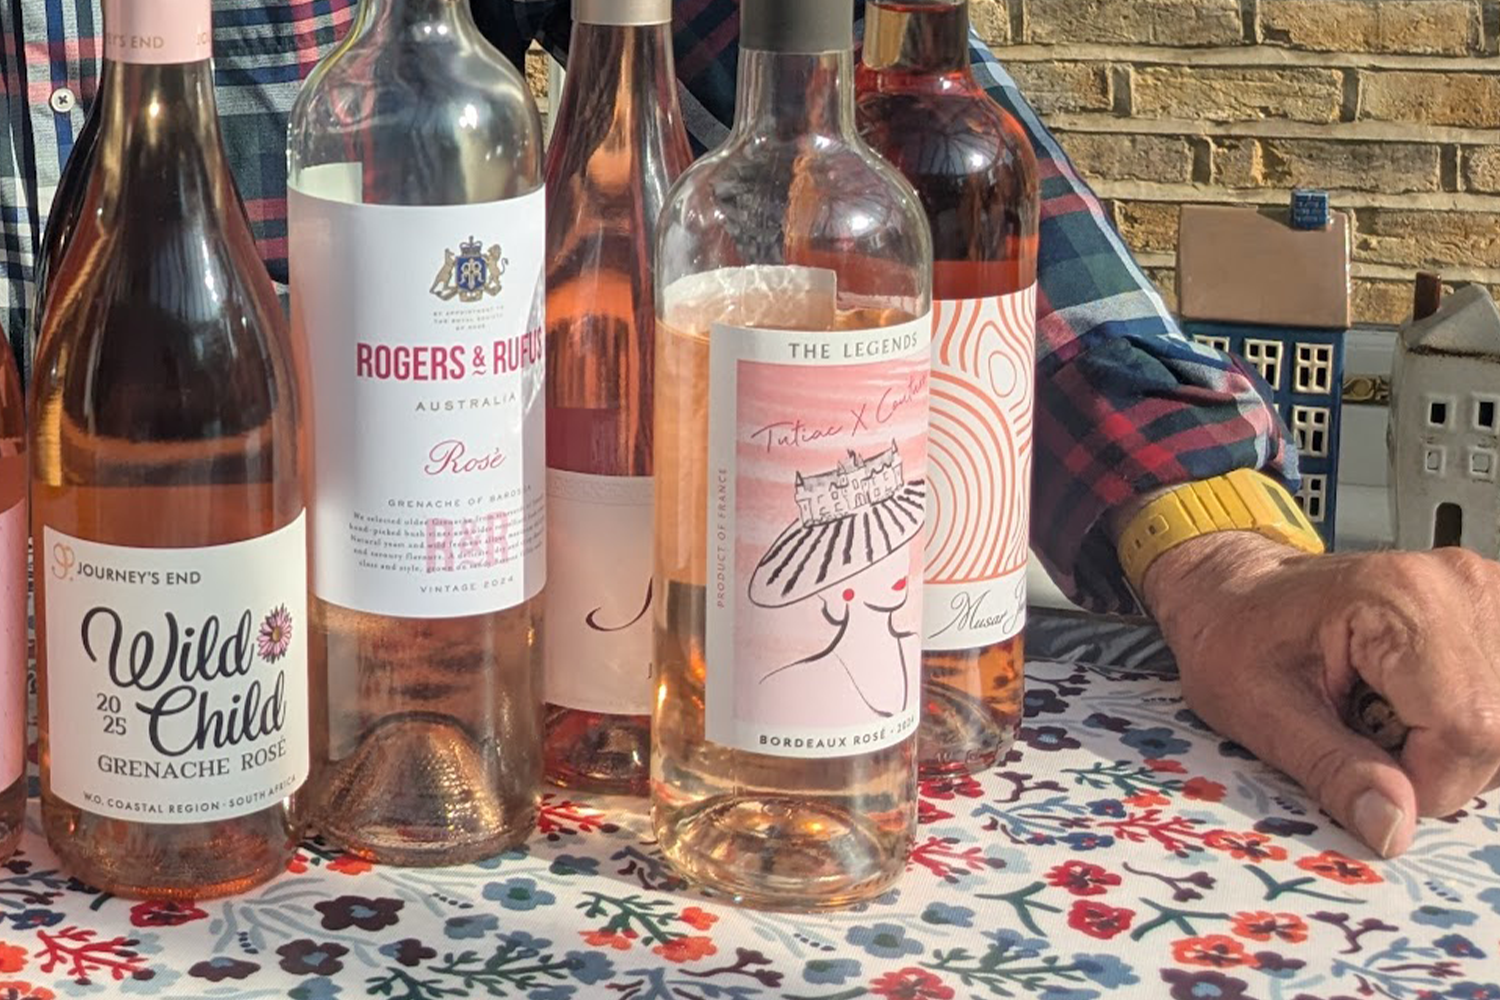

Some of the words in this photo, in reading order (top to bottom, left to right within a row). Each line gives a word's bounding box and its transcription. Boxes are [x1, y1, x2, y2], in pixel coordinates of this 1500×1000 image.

[131, 35, 164, 49] END
[356, 342, 466, 381] ROGERS
[472, 346, 487, 376] &
[493, 328, 543, 376] RUFUS
[789, 343, 831, 359] THE
[844, 332, 918, 358] LEGENDS
[415, 392, 517, 413] AUSTRALIA
[424, 439, 507, 476] Rosé
[388, 497, 460, 508] GRENACHE
[468, 496, 483, 506] OF
[718, 469, 727, 519] FRANCE
[717, 526, 726, 541] OF
[77, 562, 160, 585] JOURNEY'S
[166, 571, 201, 585] END
[717, 546, 726, 609] PRODUCT
[420, 584, 477, 593] VINTAGE
[928, 589, 1007, 639] Musar
[81, 606, 255, 691] Wild
[97, 693, 121, 713] 20
[135, 669, 287, 757] Child
[103, 715, 127, 735] 25
[759, 735, 847, 748] BORDEAUX
[98, 754, 230, 779] GRENACHE
[240, 735, 287, 772] ROSÉ
[83, 791, 104, 806] W.O.
[107, 798, 163, 814] COASTAL
[169, 802, 220, 814] REGION
[229, 792, 266, 808] SOUTH
[269, 774, 296, 796] AFRICA
